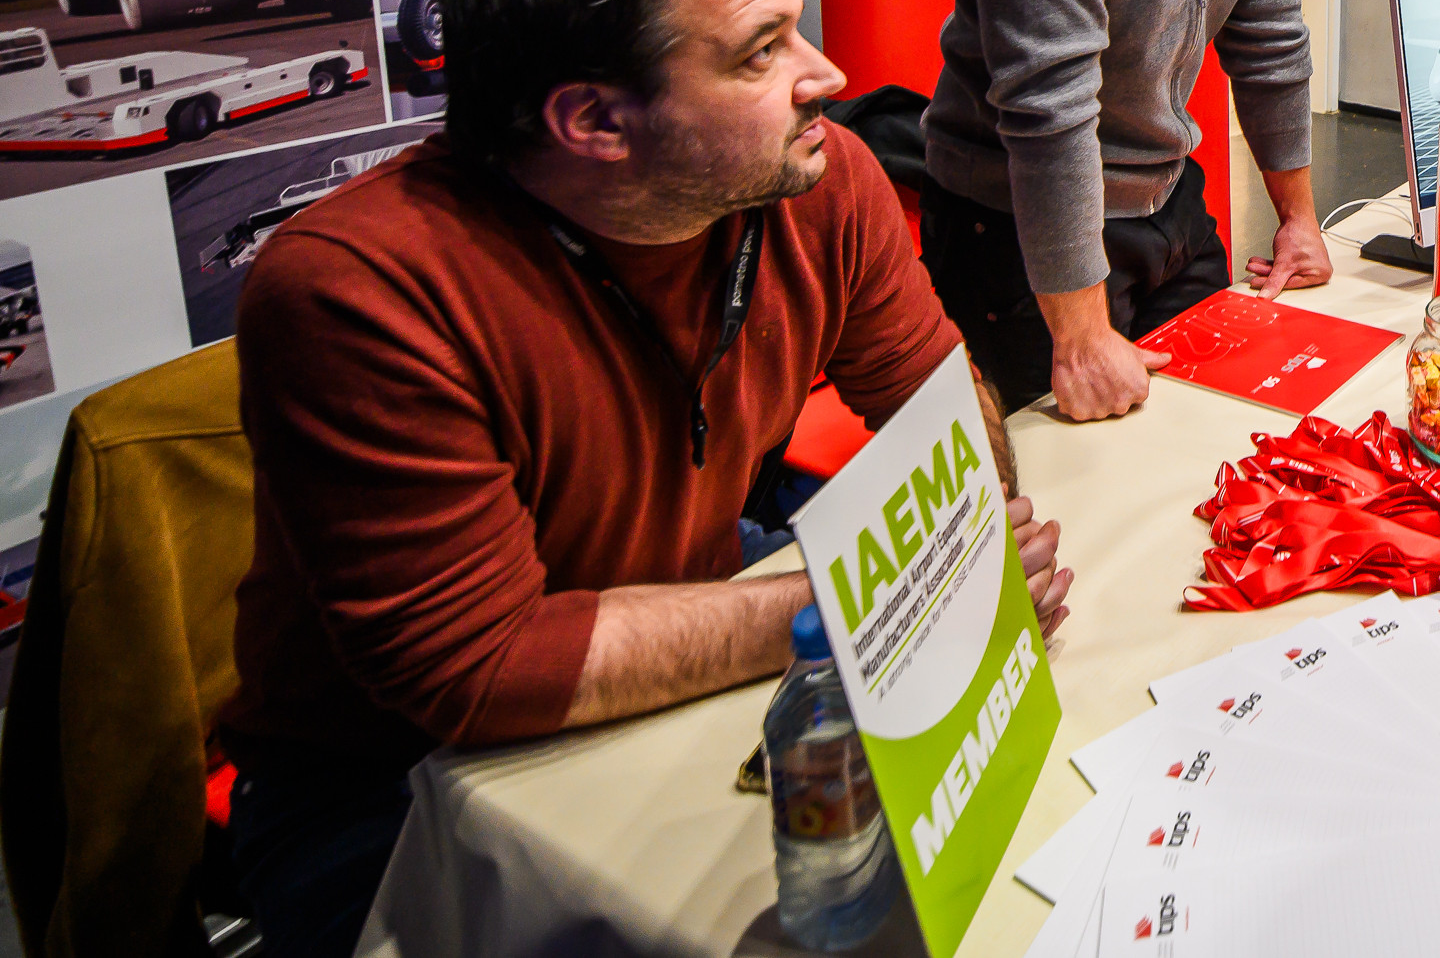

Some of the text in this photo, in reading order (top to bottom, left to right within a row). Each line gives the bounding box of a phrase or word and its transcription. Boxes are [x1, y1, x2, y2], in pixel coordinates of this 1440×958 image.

[828, 418, 981, 636] IAEMA
[924, 535, 966, 600] Association
[853, 575, 911, 661] International
[910, 541, 938, 586] Airport
[1367, 620, 1400, 639] tips
[1293, 647, 1327, 670] tips
[1230, 691, 1262, 719] tips
[910, 626, 1039, 877] MEMBER
[1182, 748, 1211, 782] tips
[1166, 810, 1192, 848] tips
[1156, 893, 1178, 937] tips
